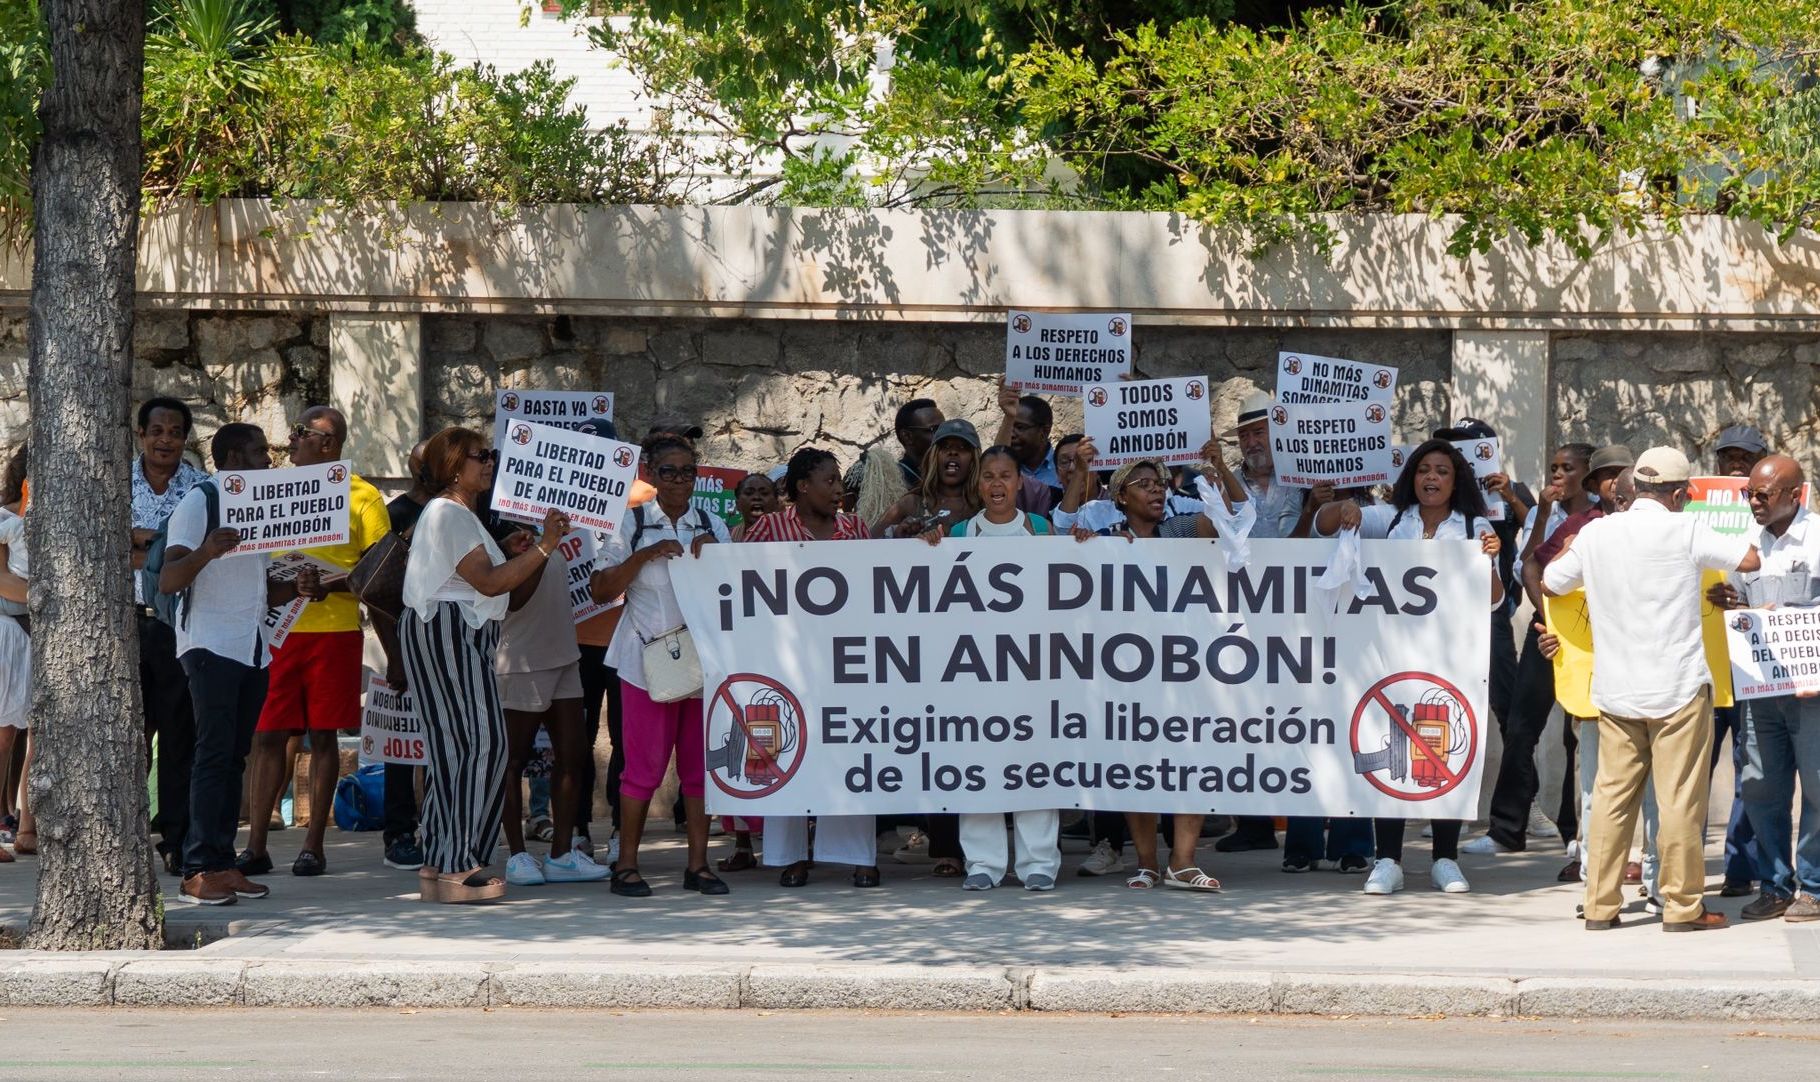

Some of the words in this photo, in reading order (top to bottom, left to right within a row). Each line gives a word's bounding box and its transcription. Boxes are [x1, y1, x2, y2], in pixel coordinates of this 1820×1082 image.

[1040, 328, 1098, 344] RESPETO
[1012, 345, 1021, 359] A
[1026, 345, 1050, 361] LOS
[1055, 347, 1125, 363] DERECHOS
[1034, 364, 1102, 382] HUMANOS
[1312, 362, 1329, 378] NO
[1333, 364, 1363, 383] MÁS
[1120, 384, 1173, 405] TODOS
[1301, 377, 1370, 400] DINAMITAS
[523, 399, 567, 416] BASTA
[571, 400, 588, 417] YA
[1117, 408, 1178, 429] SOMOS
[1297, 418, 1356, 435] RESPETO
[1109, 429, 1187, 454] ANNOBÓN
[1275, 438, 1283, 452] A
[1286, 438, 1309, 454] LOS
[1314, 435, 1386, 454] DERECHOS
[535, 440, 605, 470] LIBERTAD
[1296, 456, 1364, 474] HUMANOS
[505, 457, 543, 480] PARA
[548, 465, 564, 484] EL
[569, 470, 625, 497] PUEBLO
[693, 474, 724, 494] MÁS
[253, 479, 321, 501] LIBERTAD
[513, 481, 534, 499] DE
[537, 486, 608, 516] ANNOBÓN
[227, 506, 264, 523] PARA
[270, 503, 286, 519] EL
[291, 495, 344, 516] PUEBLO
[240, 526, 258, 541] DE
[262, 515, 331, 539] ANNOBÓN
[258, 539, 296, 550] DINAMITAS
[298, 538, 307, 546] EN
[559, 536, 583, 561] OP
[718, 566, 849, 631] ¡NO
[873, 551, 1024, 614] MÁS
[1047, 563, 1438, 616] DINAMIAS
[1751, 632, 1760, 645] A
[1764, 632, 1780, 644] LA
[1785, 629, 1820, 642] DECIS
[833, 636, 921, 684] EN
[941, 623, 1336, 685] ANNOBÓN!
[1752, 648, 1776, 663] DEL
[1780, 645, 1820, 660] PUEBL
[1772, 662, 1820, 679] ANNOB
[373, 690, 413, 712] NNOBÓN
[366, 710, 420, 733] TERMINIO
[822, 704, 1034, 755] Exigimos
[1051, 700, 1087, 739] la
[1105, 701, 1336, 745] liberación
[383, 737, 424, 760] STOP
[845, 753, 903, 793] de
[922, 752, 986, 792] los
[1003, 753, 1312, 793] secuestrados
